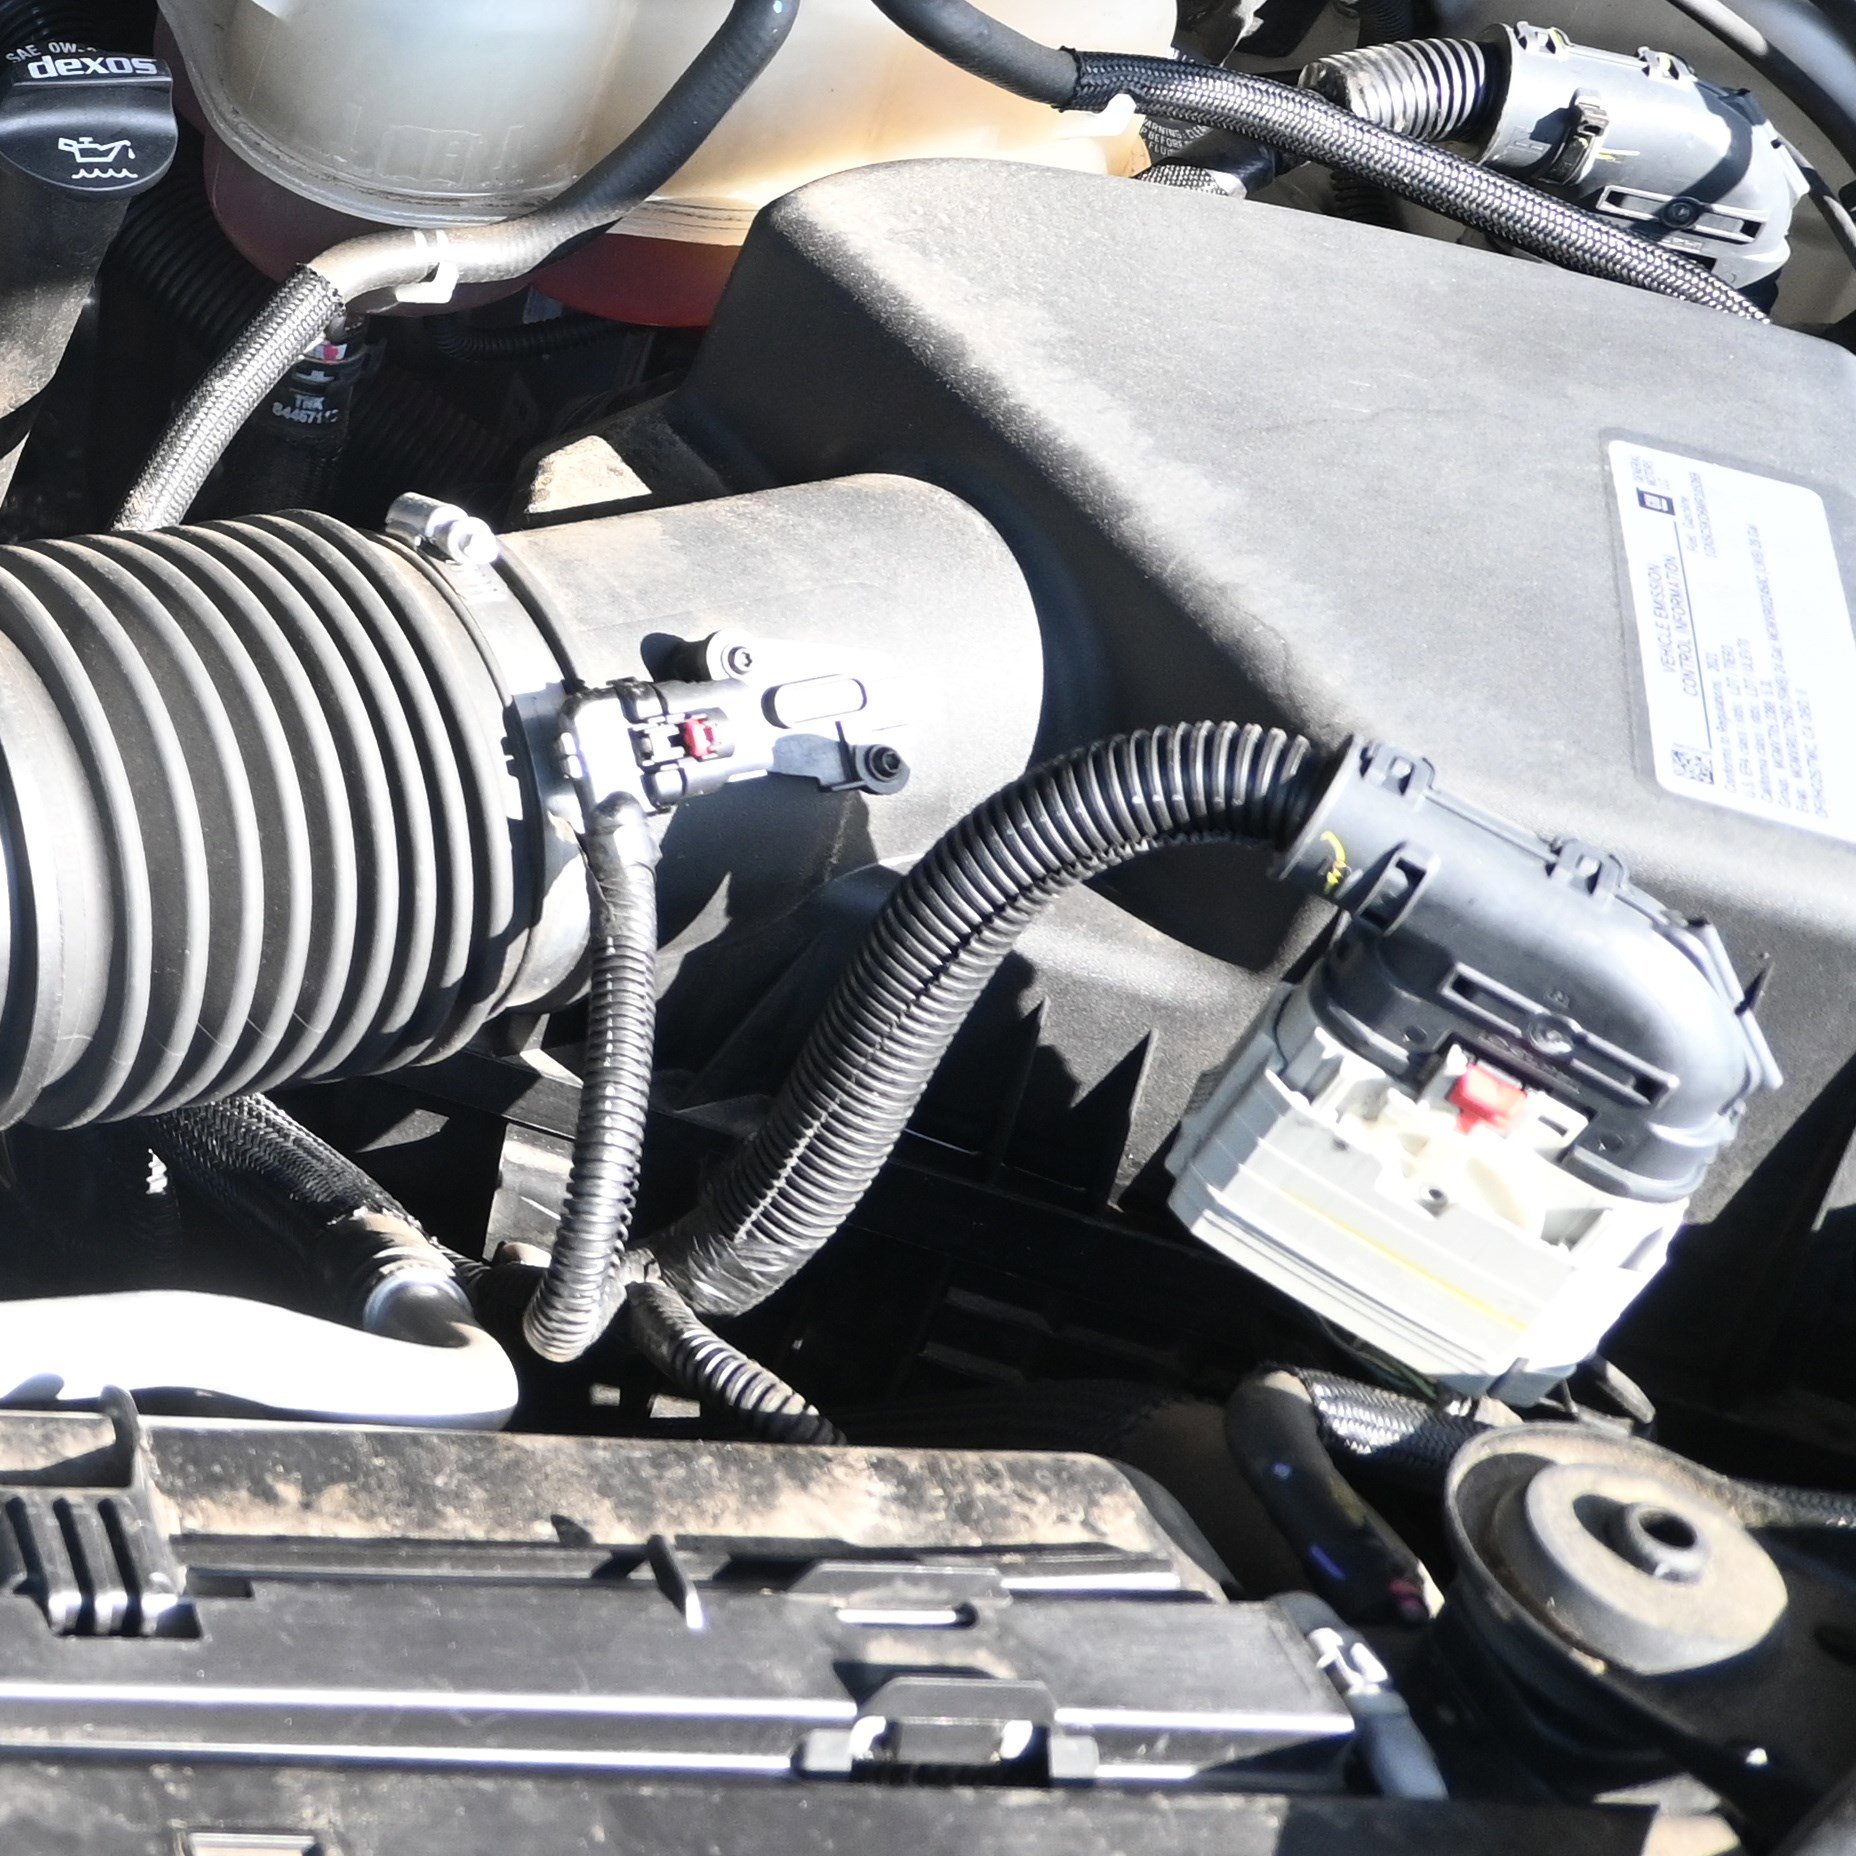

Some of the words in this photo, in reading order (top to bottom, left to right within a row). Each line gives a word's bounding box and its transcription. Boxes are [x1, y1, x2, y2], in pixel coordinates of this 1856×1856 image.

[5, 44, 42, 63] SAE
[48, 42, 97, 54] 0W-
[27, 55, 158, 79] dexos
[1144, 120, 1187, 139] ARNING:
[1646, 561, 1668, 619] EMISSION
[1663, 552, 1688, 634] INFORMATION
[1655, 620, 1677, 675] VEHICLE
[1676, 634, 1698, 697] CONTROL
